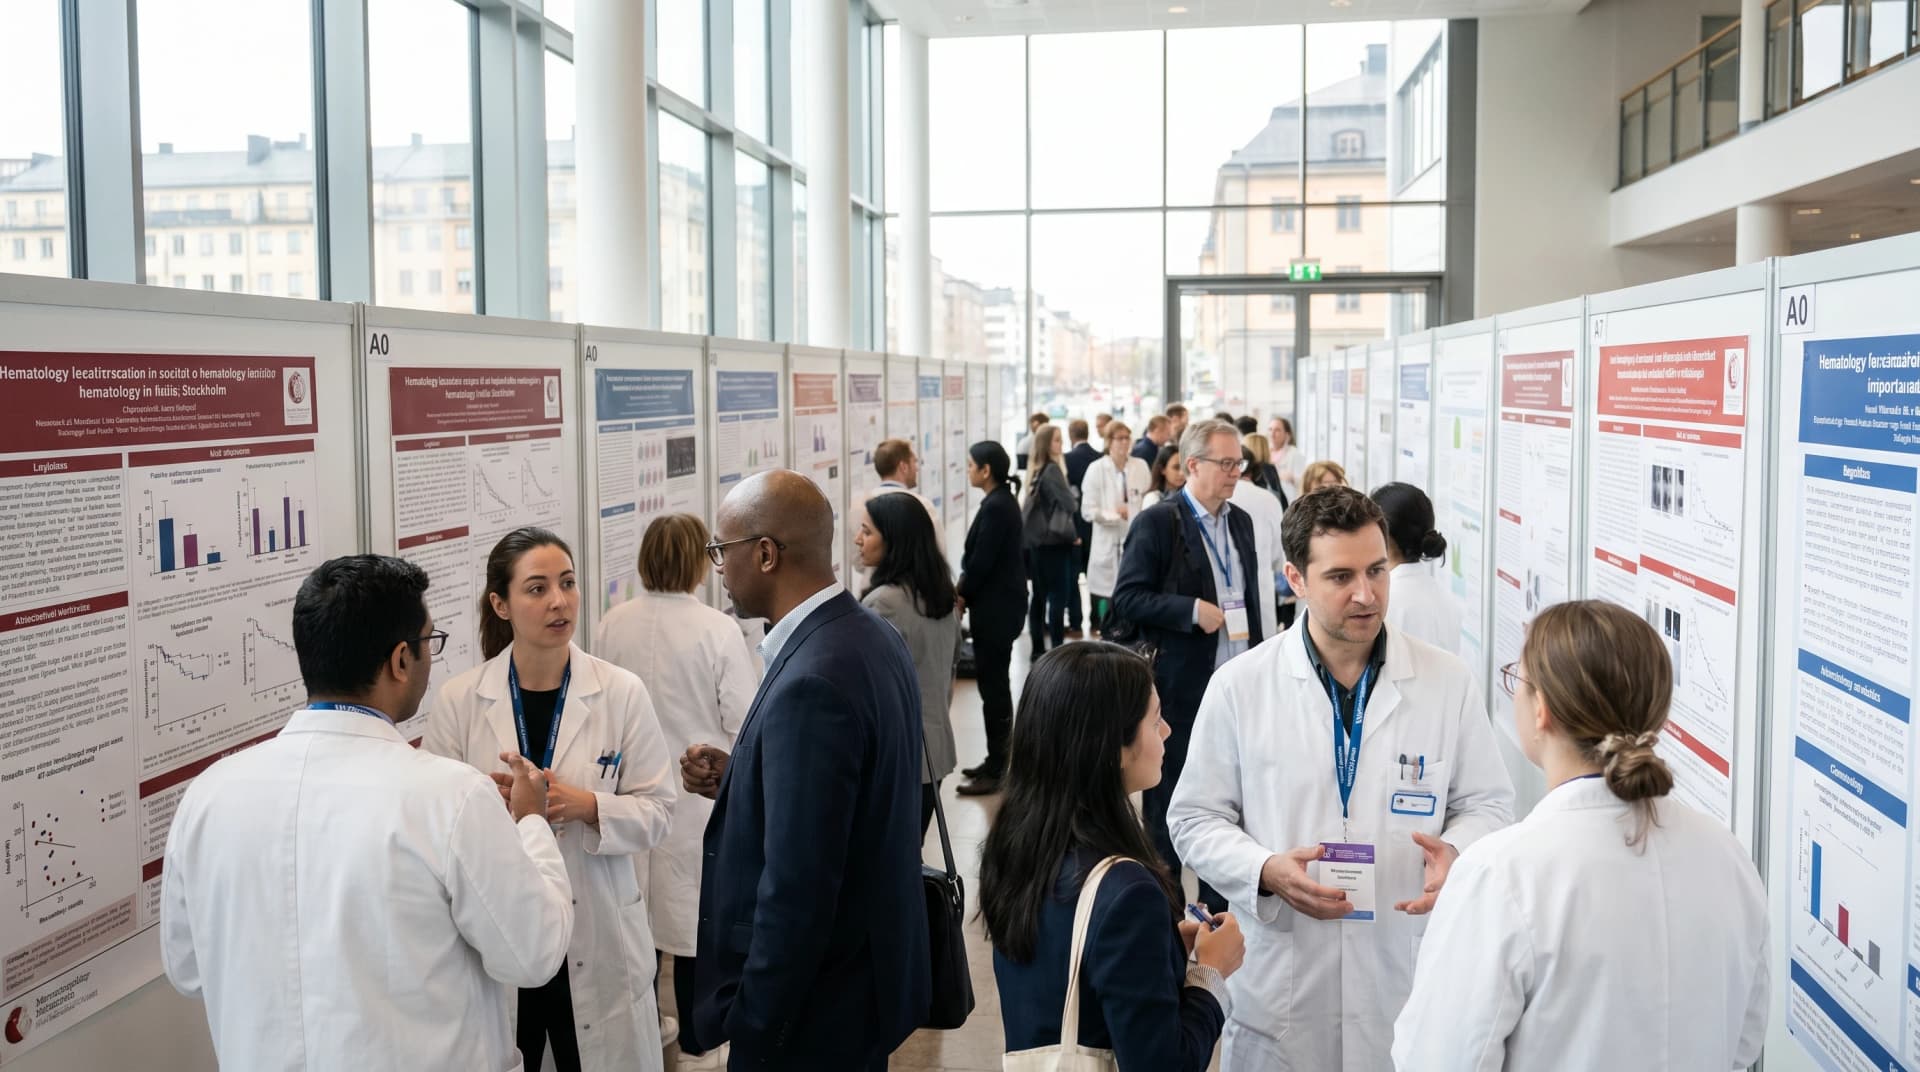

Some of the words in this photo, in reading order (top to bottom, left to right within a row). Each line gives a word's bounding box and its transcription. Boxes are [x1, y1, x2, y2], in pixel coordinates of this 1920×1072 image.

[1786, 294, 1808, 326] A0
[369, 333, 389, 355] A0
[585, 345, 597, 362] A0
[1819, 353, 1866, 373] Hematology
[0, 365, 69, 383] Hematology
[148, 367, 157, 378] in
[200, 367, 245, 382] hematology
[80, 384, 141, 400] hematology
[143, 385, 152, 397] in
[182, 384, 227, 396] Stockholm
